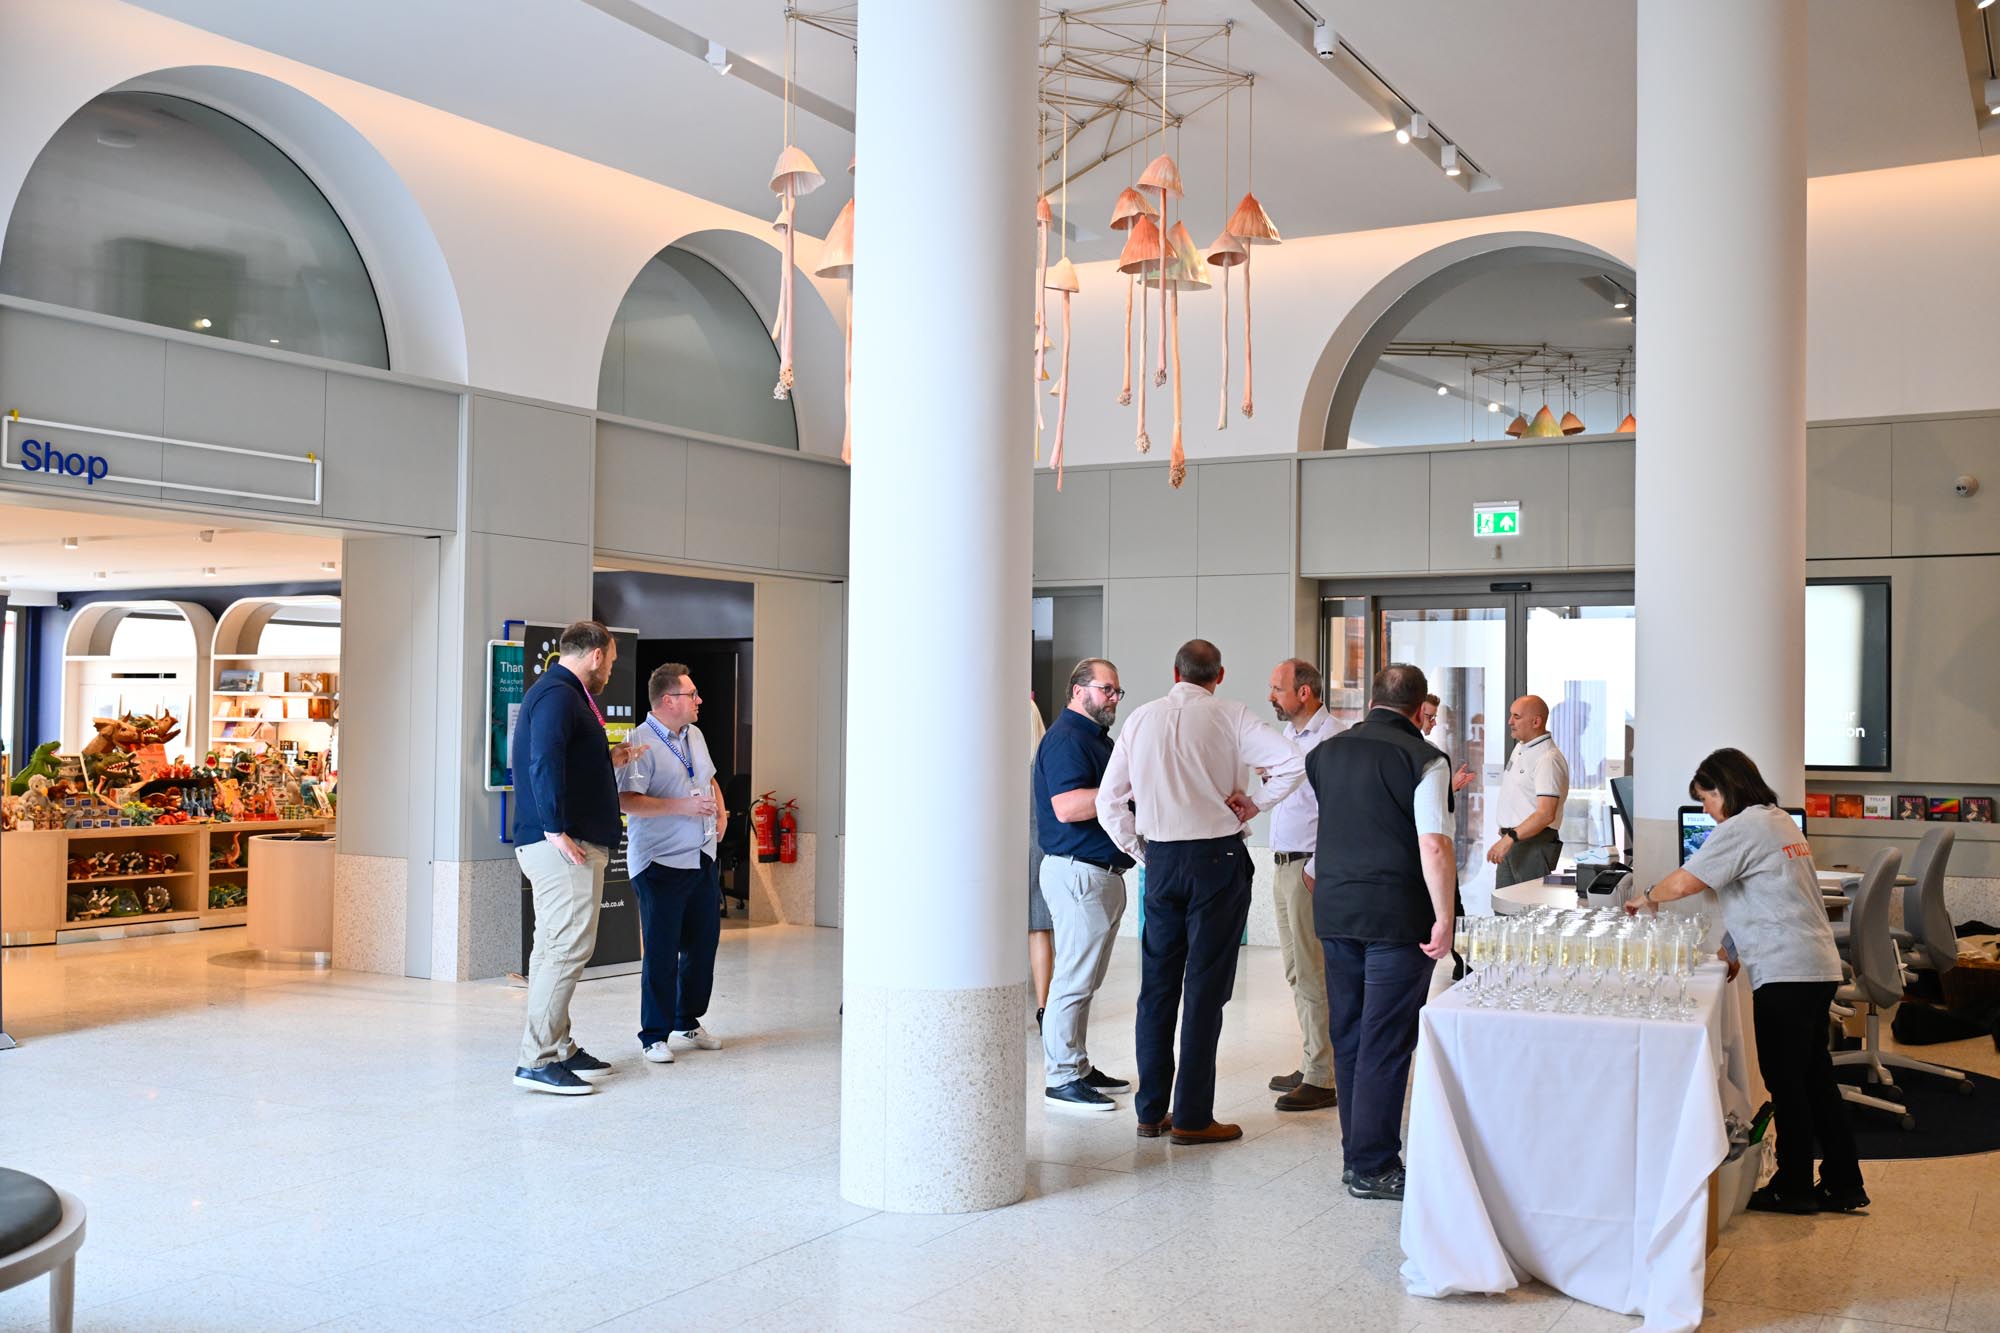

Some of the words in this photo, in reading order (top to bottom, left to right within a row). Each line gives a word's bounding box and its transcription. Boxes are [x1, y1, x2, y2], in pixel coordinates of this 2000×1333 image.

[21, 439, 109, 485] Shop
[500, 661, 524, 673] Than
[1782, 842, 1812, 859] TULL
